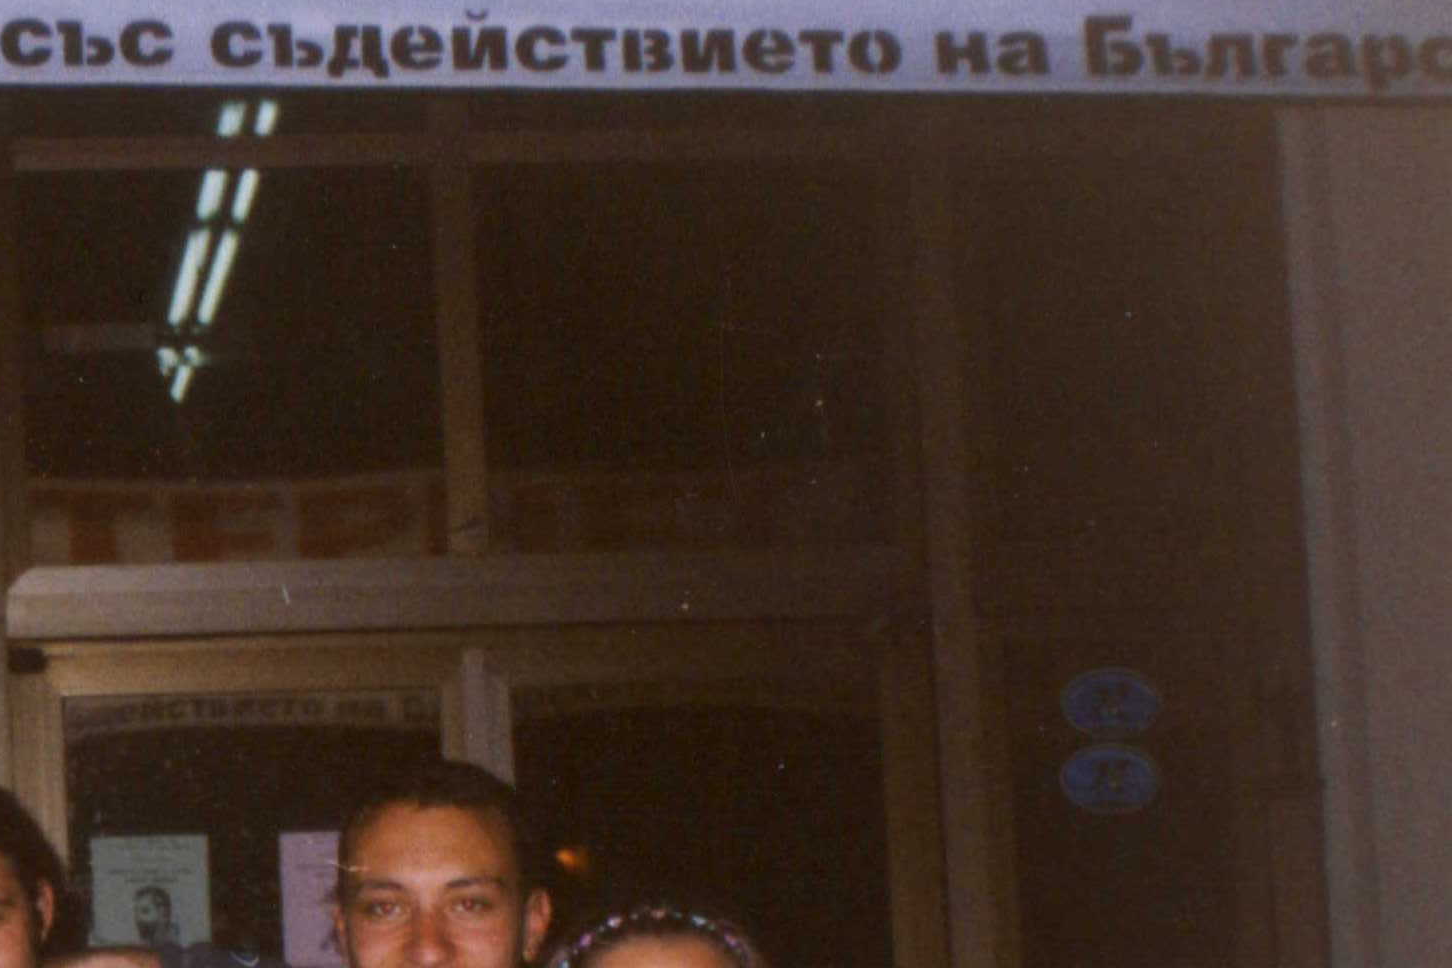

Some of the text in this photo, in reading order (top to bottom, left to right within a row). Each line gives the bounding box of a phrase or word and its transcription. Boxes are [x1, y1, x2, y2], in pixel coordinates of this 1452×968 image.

[0, 19, 174, 68] със
[210, 12, 903, 79] съдействието
[934, 30, 1052, 78] на
